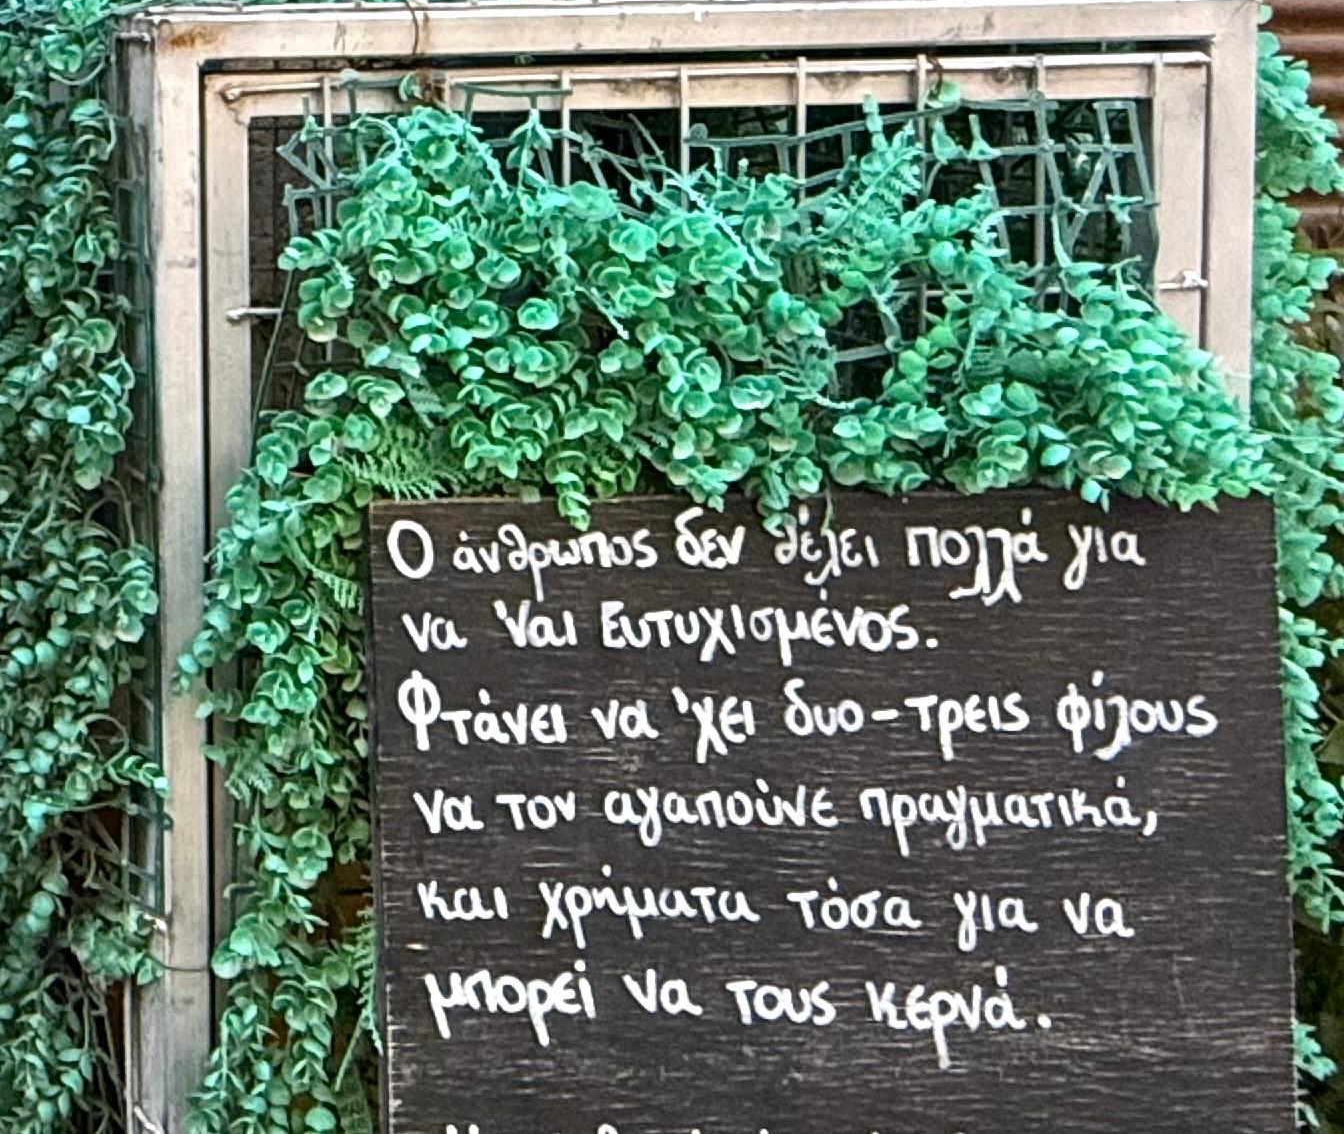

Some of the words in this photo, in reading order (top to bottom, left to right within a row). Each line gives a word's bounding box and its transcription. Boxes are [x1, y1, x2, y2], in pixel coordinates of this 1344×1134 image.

[387, 520, 433, 578] Ο
[453, 520, 657, 602] άνθρωπος
[675, 507, 745, 569] δεν
[907, 509, 1048, 606] πολλά
[1064, 525, 1145, 590] για
[402, 613, 467, 652] να
[398, 671, 567, 751] Φτάνει
[591, 700, 659, 739] να
[784, 678, 1029, 761] δυο-τρεις
[1057, 671, 1218, 760] φίλους
[413, 789, 484, 833] να
[496, 791, 575, 829] τον
[605, 779, 839, 846] αγαπούνε
[860, 776, 1157, 857] πραγματικά,
[418, 881, 508, 920] και
[539, 865, 760, 949] χρήματα
[787, 878, 922, 929] τόσα
[954, 891, 1038, 951] για
[1063, 893, 1135, 937] να
[423, 959, 596, 1047] μπορεί
[623, 971, 703, 1015] να
[726, 980, 841, 1025] τους
[866, 966, 1051, 1072] κερνά.
